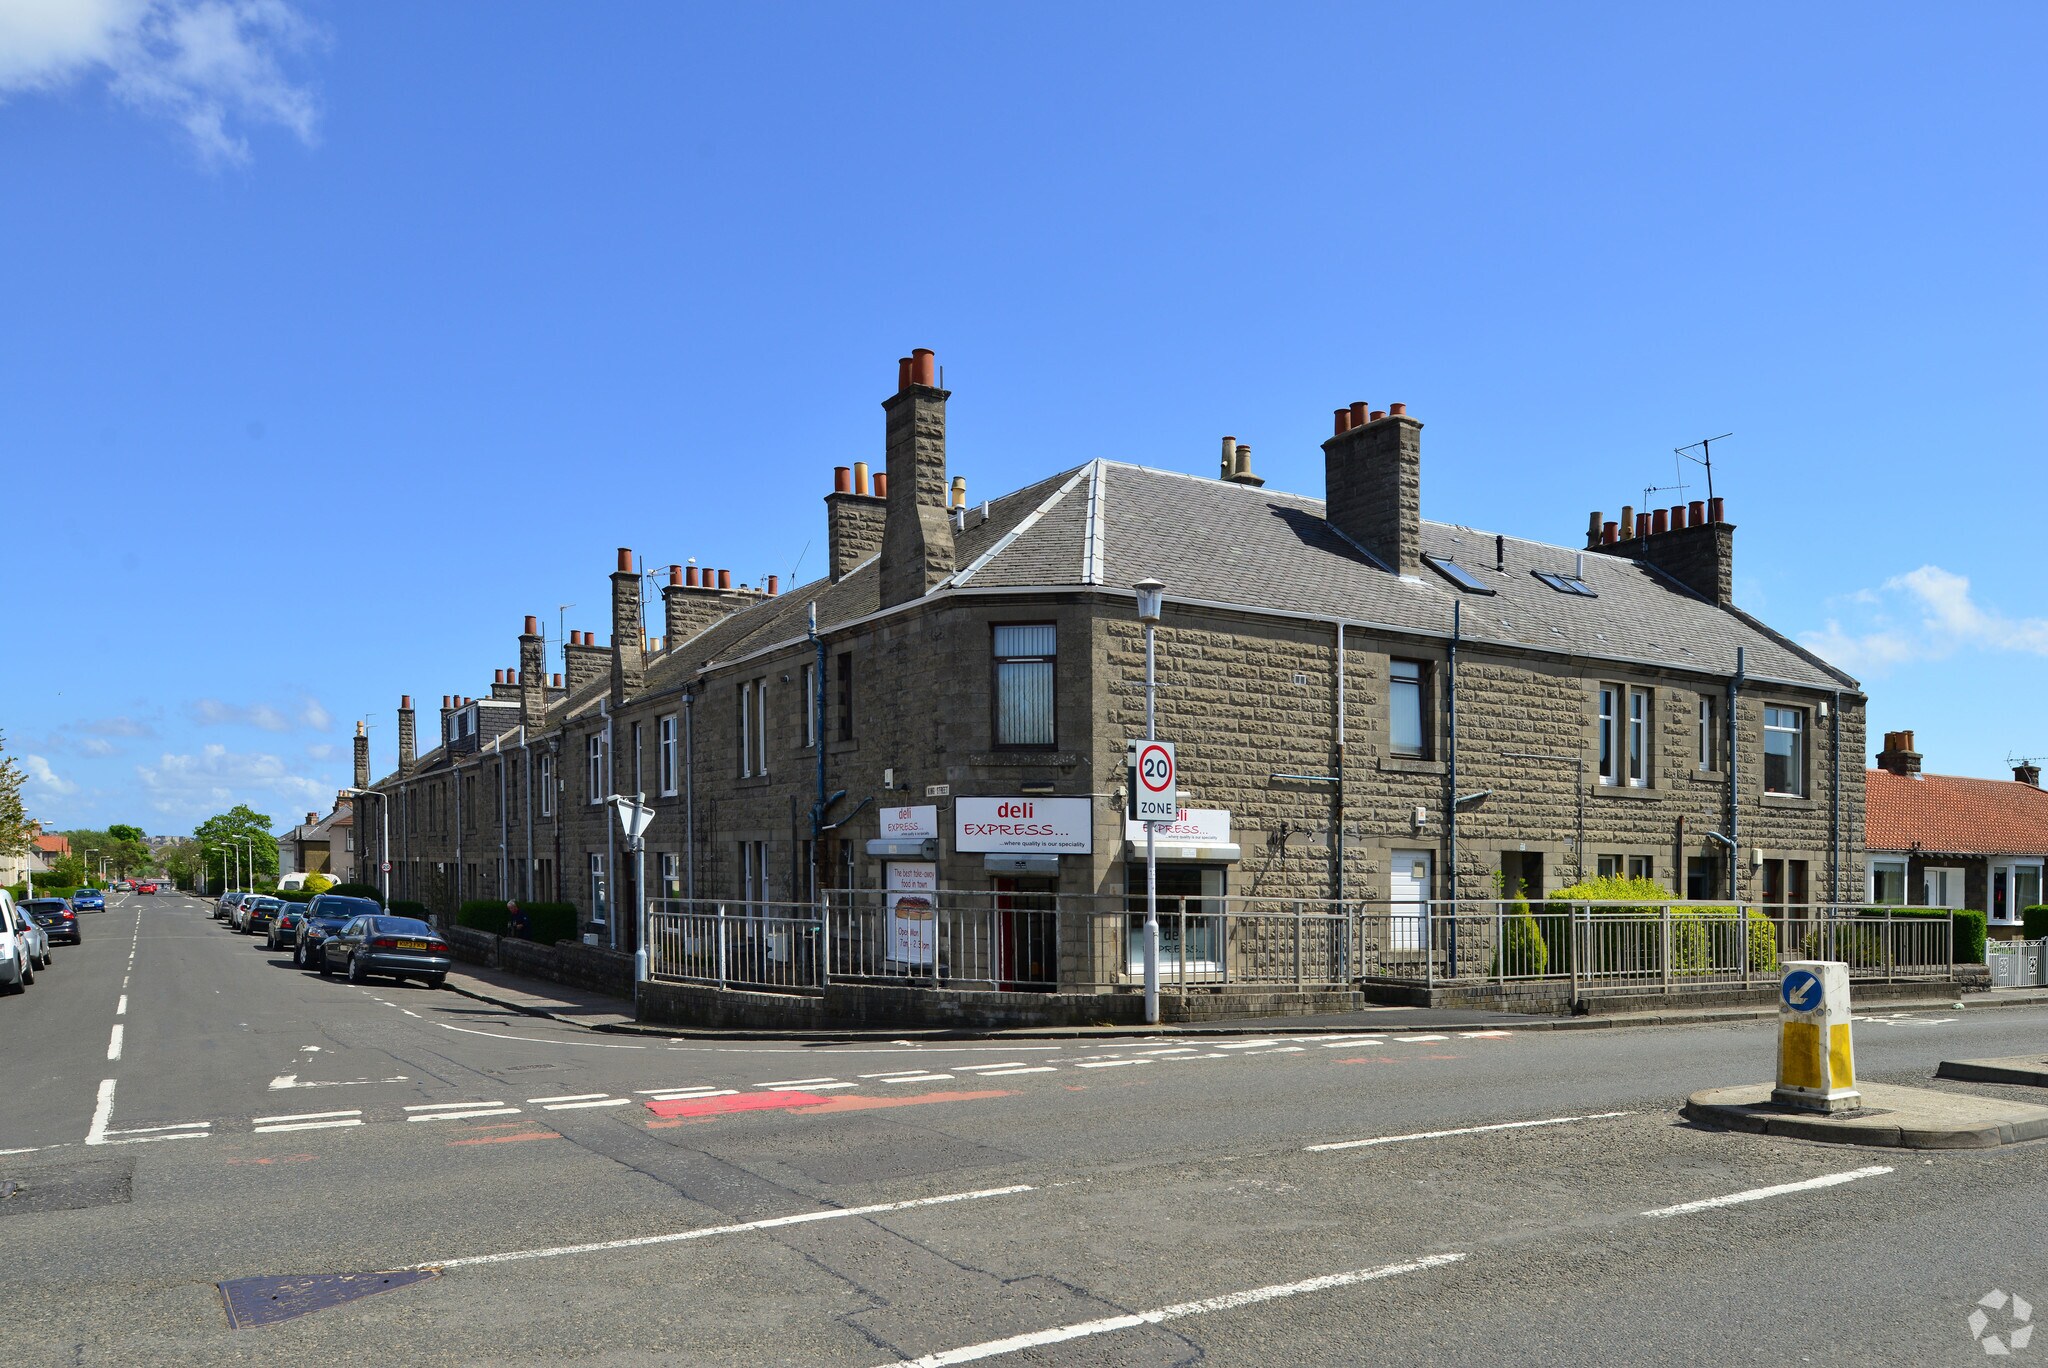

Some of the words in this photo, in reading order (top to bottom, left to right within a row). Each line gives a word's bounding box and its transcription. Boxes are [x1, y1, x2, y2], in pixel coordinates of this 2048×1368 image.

[1145, 759, 1168, 778] 20
[936, 785, 948, 794] STREET
[899, 807, 912, 819] deli
[997, 802, 1033, 818] deli
[1141, 802, 1172, 814] ZONE
[964, 823, 1069, 836] EXPRESS...
[1059, 841, 1085, 849] speciality
[894, 868, 902, 877] The
[903, 869, 912, 877] best
[901, 879, 911, 888] food
